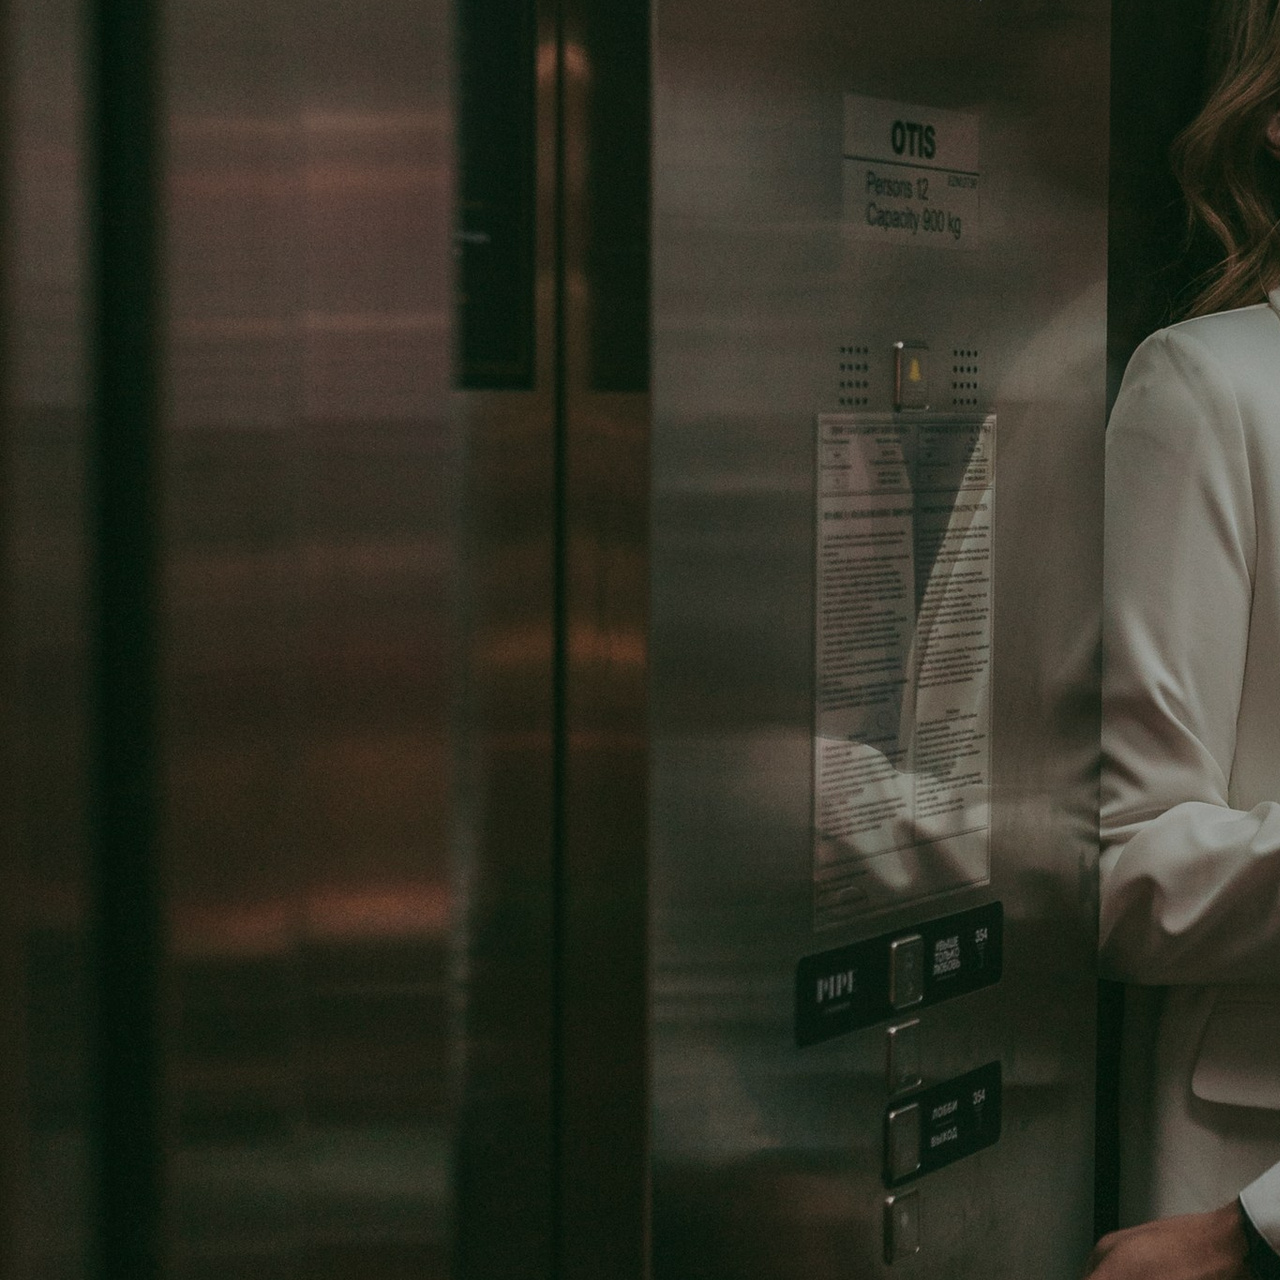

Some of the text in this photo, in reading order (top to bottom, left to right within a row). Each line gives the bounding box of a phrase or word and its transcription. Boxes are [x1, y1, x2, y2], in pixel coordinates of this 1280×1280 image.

[891, 120, 936, 160] OTIS
[866, 171, 914, 199] Persons
[866, 202, 919, 235] Capacity
